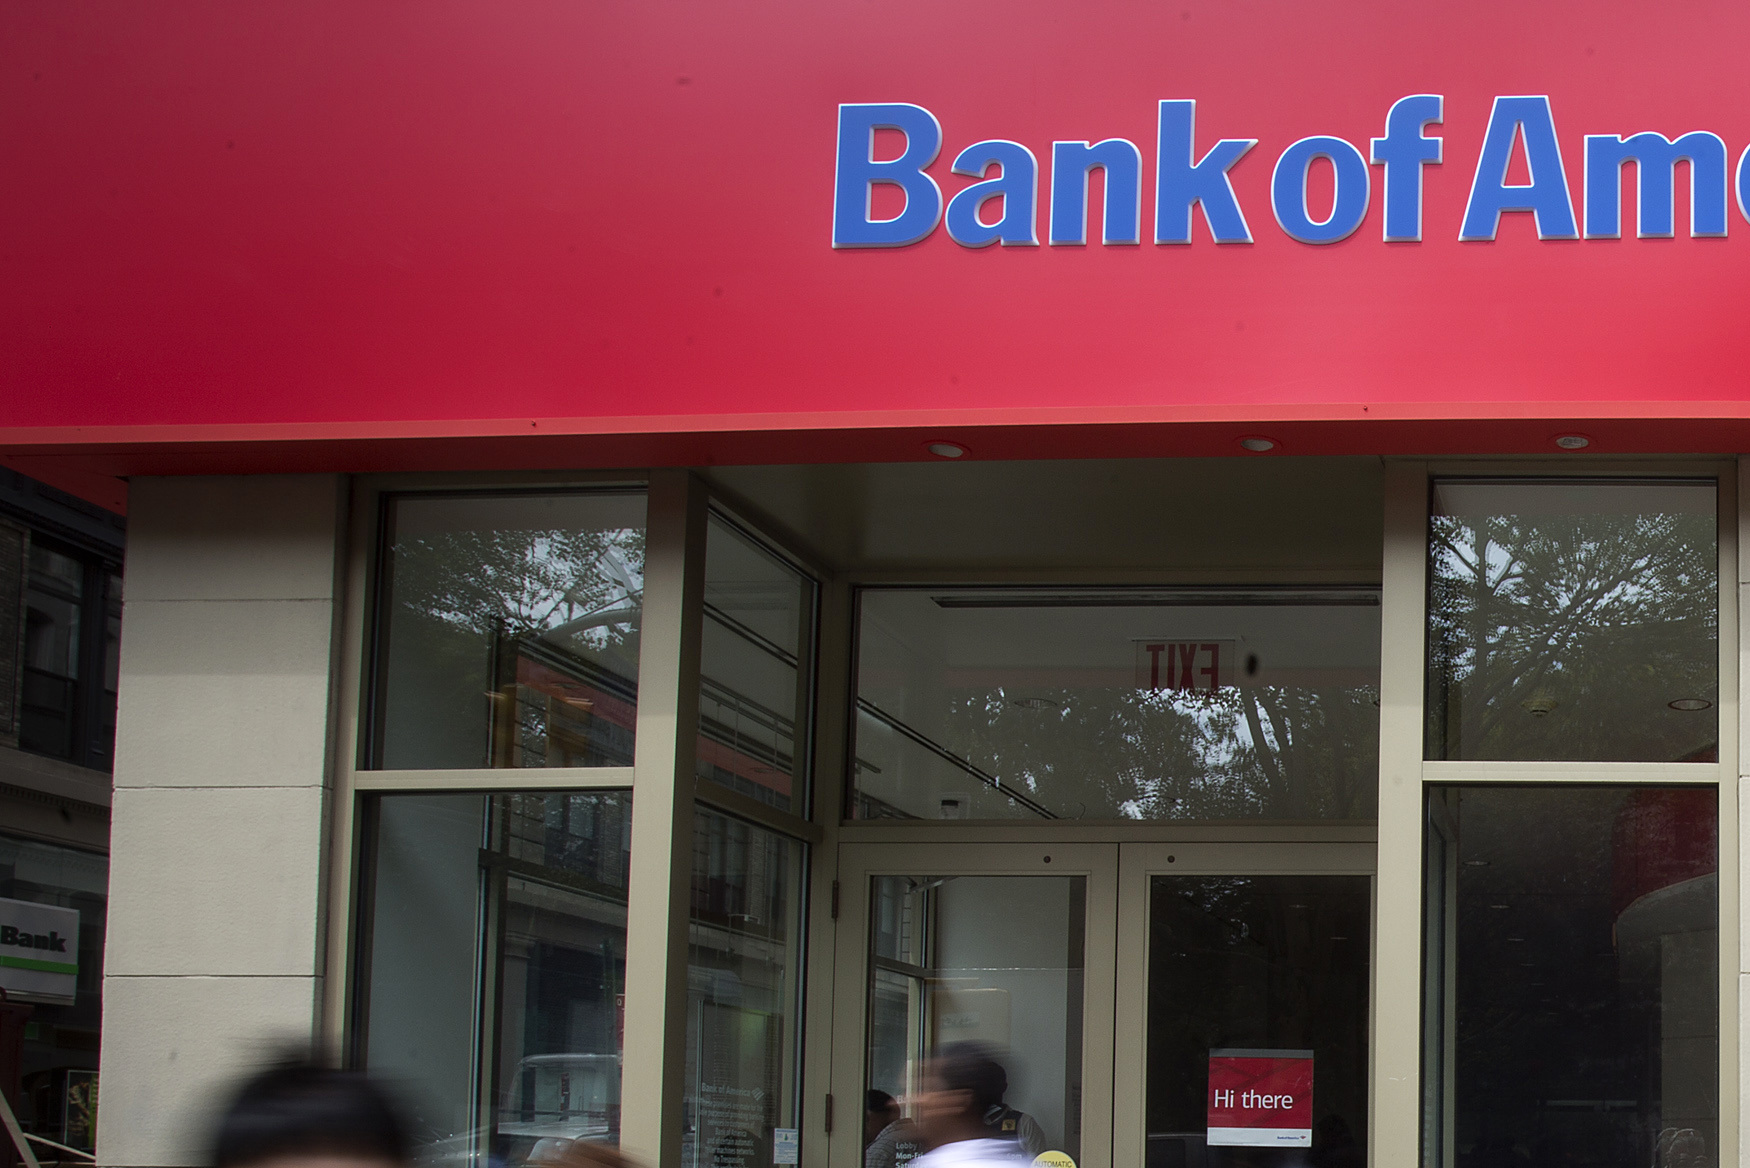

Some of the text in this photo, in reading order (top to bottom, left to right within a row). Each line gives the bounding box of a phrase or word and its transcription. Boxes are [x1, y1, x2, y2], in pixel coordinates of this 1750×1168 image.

[831, 97, 1257, 249] Bank
[1270, 93, 1444, 247] of
[1, 925, 66, 953] Bank
[1214, 1089, 1293, 1109] Hi there
[896, 1141, 917, 1152] Lobby
[896, 1152, 924, 1160] Mon-Fri
[1034, 1160, 1073, 1168] AUTOMATIC
